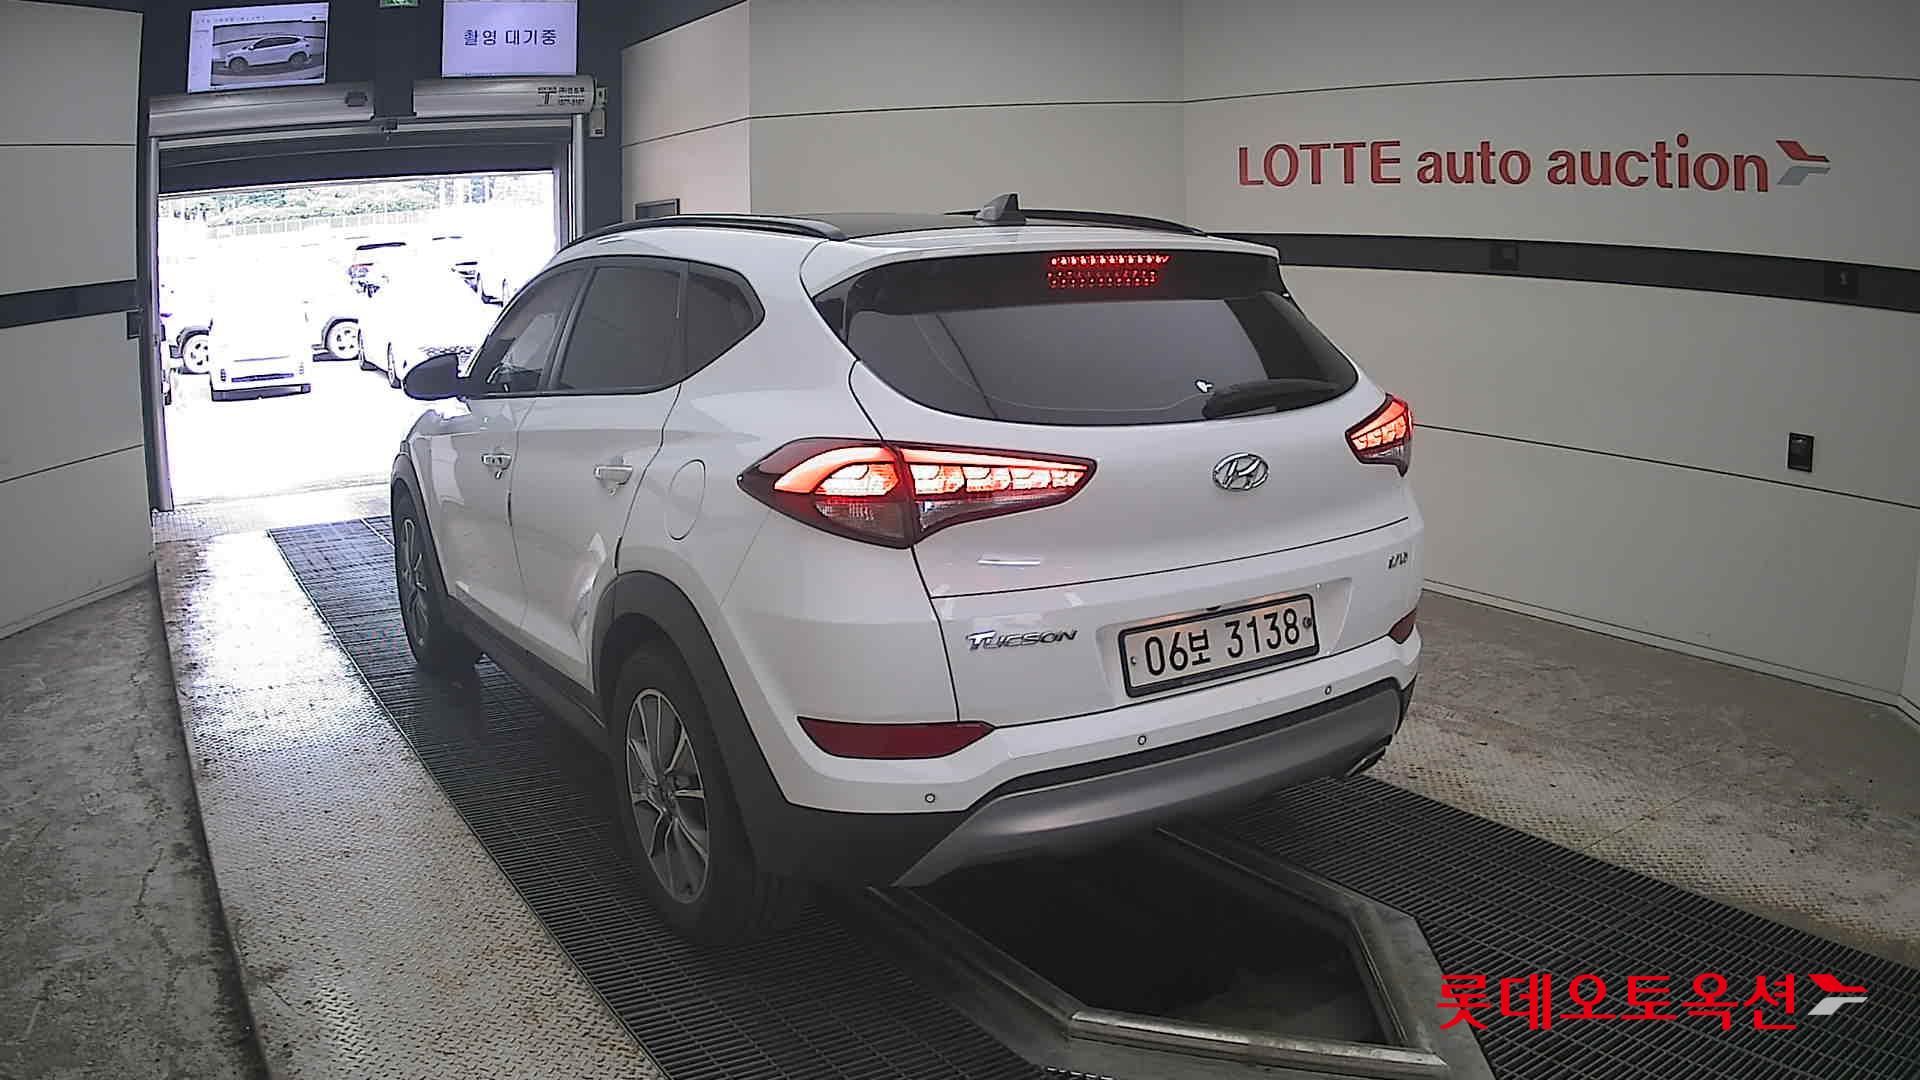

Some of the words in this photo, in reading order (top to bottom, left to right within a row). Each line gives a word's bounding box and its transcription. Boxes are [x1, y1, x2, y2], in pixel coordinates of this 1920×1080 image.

[505, 29, 558, 47] 대기중
[1239, 140, 1401, 188] LOTTE
[1416, 140, 1531, 185] auto
[1547, 134, 1770, 192] auction
[966, 630, 1078, 651] TUCSON
[1144, 628, 1210, 676] 06보
[1225, 608, 1300, 658] 3138
